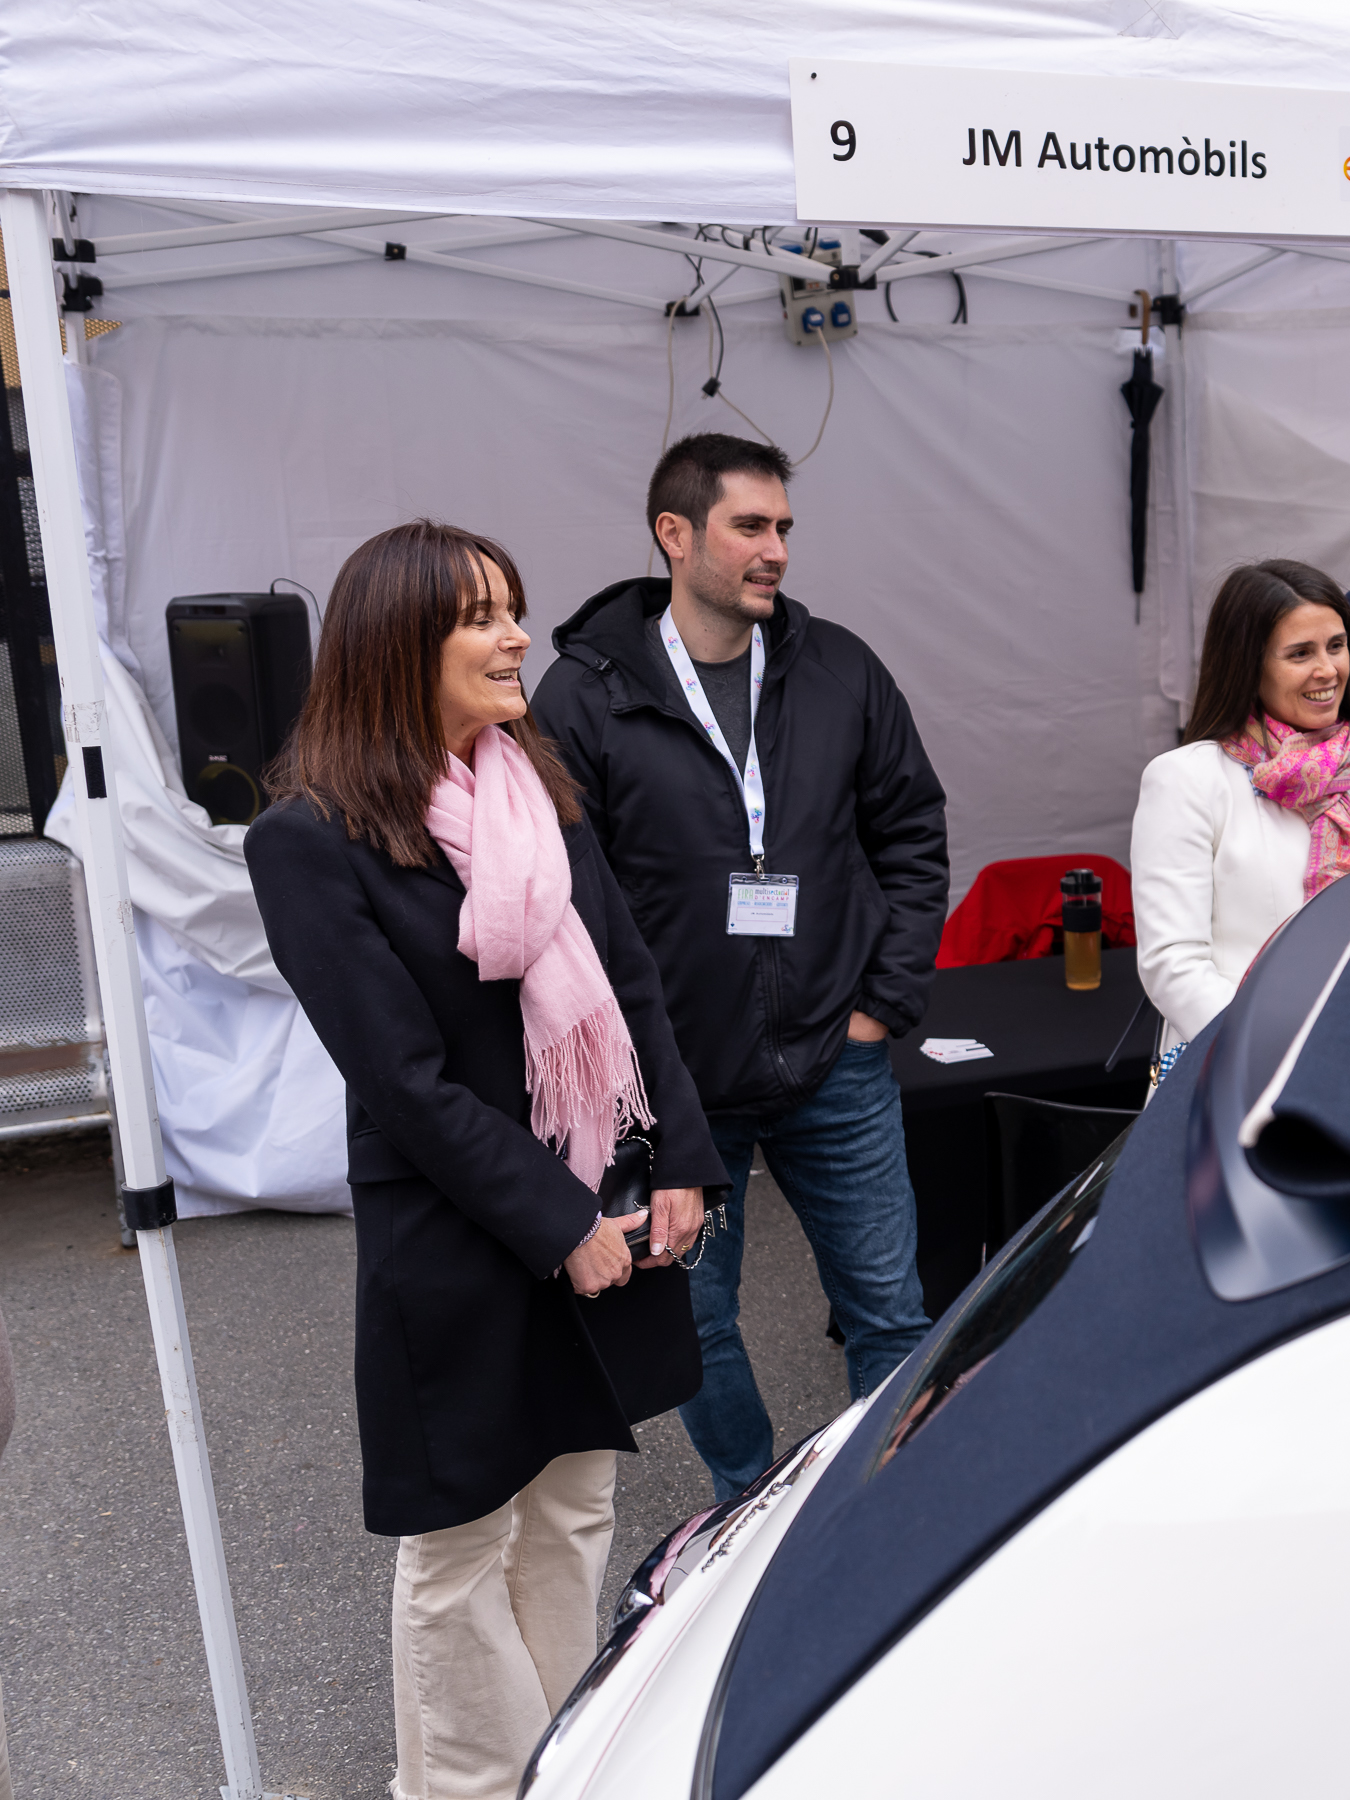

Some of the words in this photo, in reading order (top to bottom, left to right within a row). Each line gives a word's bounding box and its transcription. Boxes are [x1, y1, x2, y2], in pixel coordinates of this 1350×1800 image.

[829, 119, 858, 163] 9
[961, 126, 1023, 168] JM
[1036, 130, 1268, 180] Automòbils
[738, 888, 754, 900] FIRA
